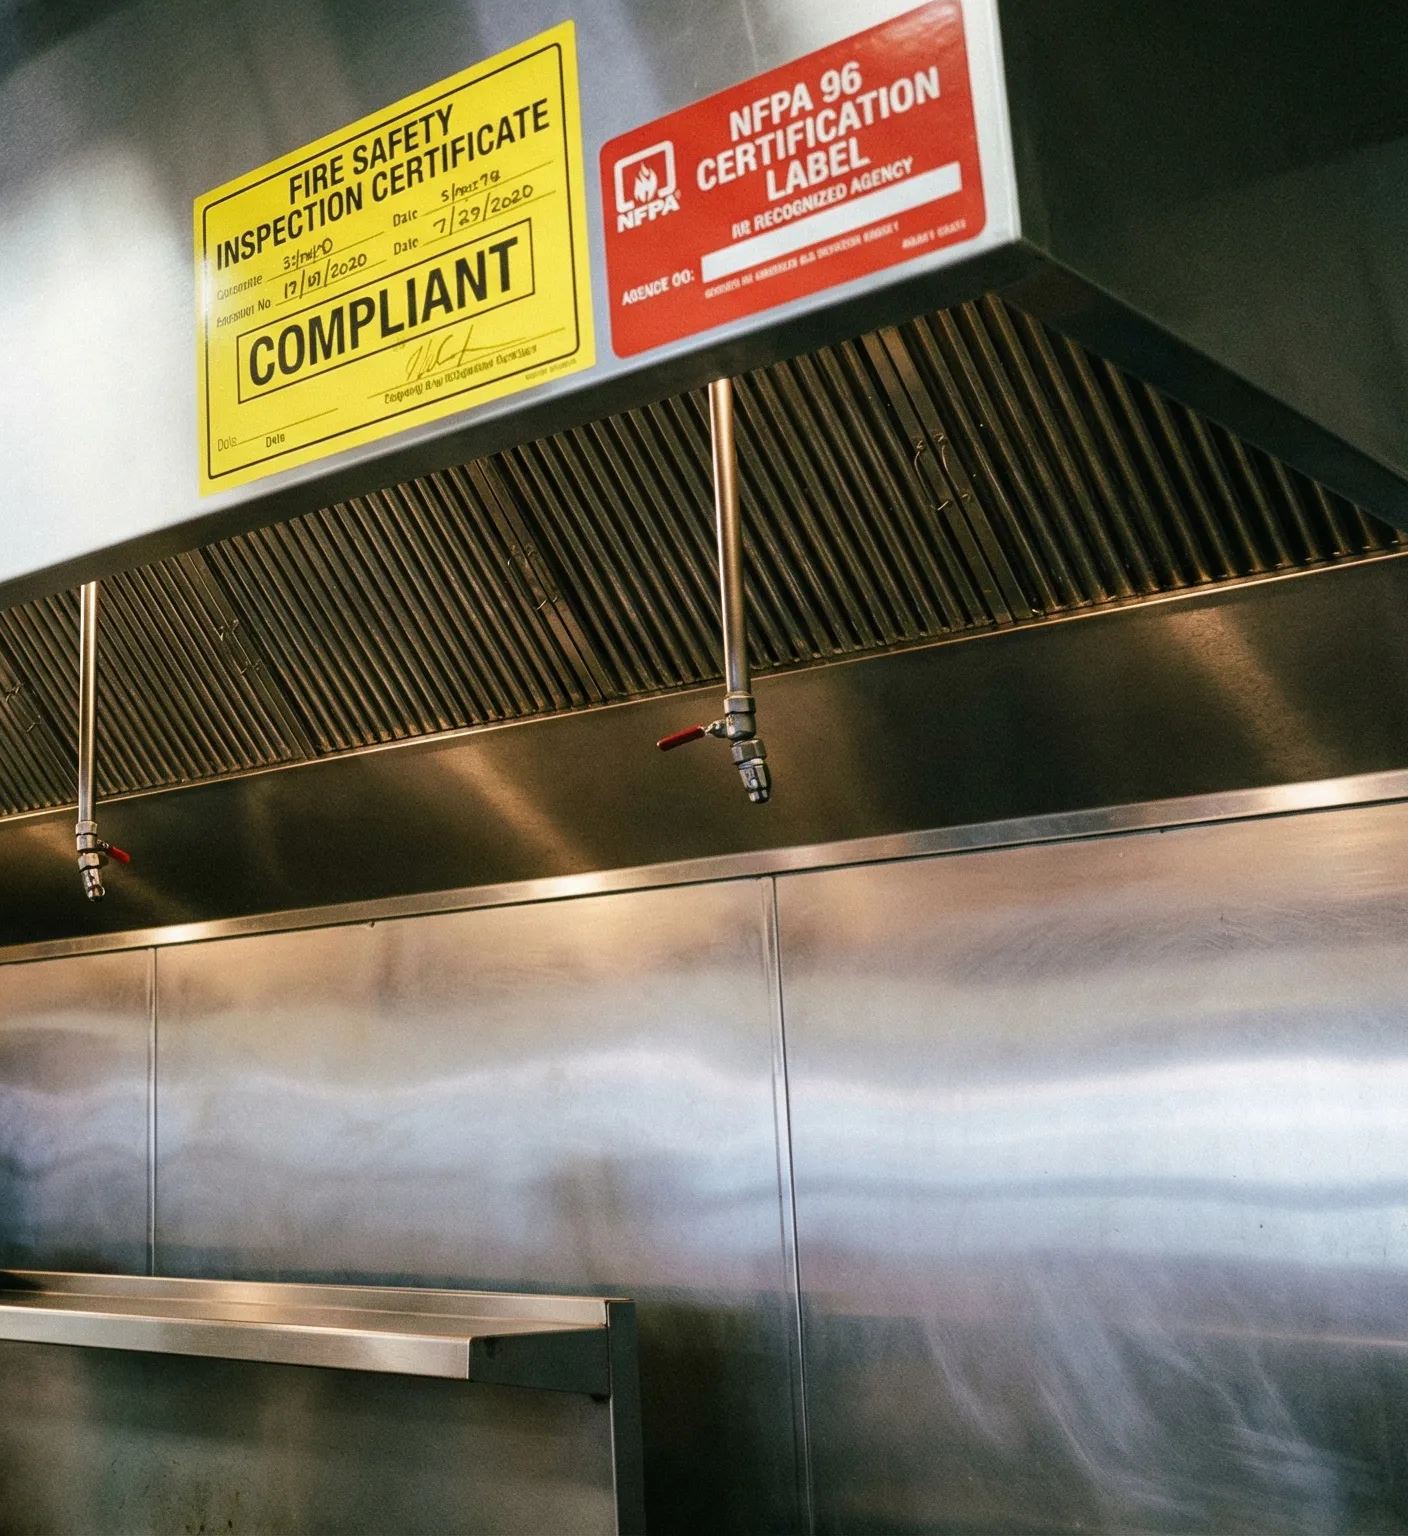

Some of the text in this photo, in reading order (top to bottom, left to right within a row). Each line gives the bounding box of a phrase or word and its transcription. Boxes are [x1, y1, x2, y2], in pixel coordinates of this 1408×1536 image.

[696, 65, 941, 192] CERTIFICATION
[729, 61, 863, 142] NFPA 96
[216, 98, 550, 271] INSPECTION CERTIFICATE
[289, 103, 453, 205] FIRE SAFETY
[753, 183, 847, 232] RECOGNIZED
[850, 156, 913, 195] AGENCY
[766, 137, 871, 202] LABEL
[617, 194, 681, 233] NFPA
[249, 237, 518, 387] COMPLIANT
[258, 298, 271, 312] No
